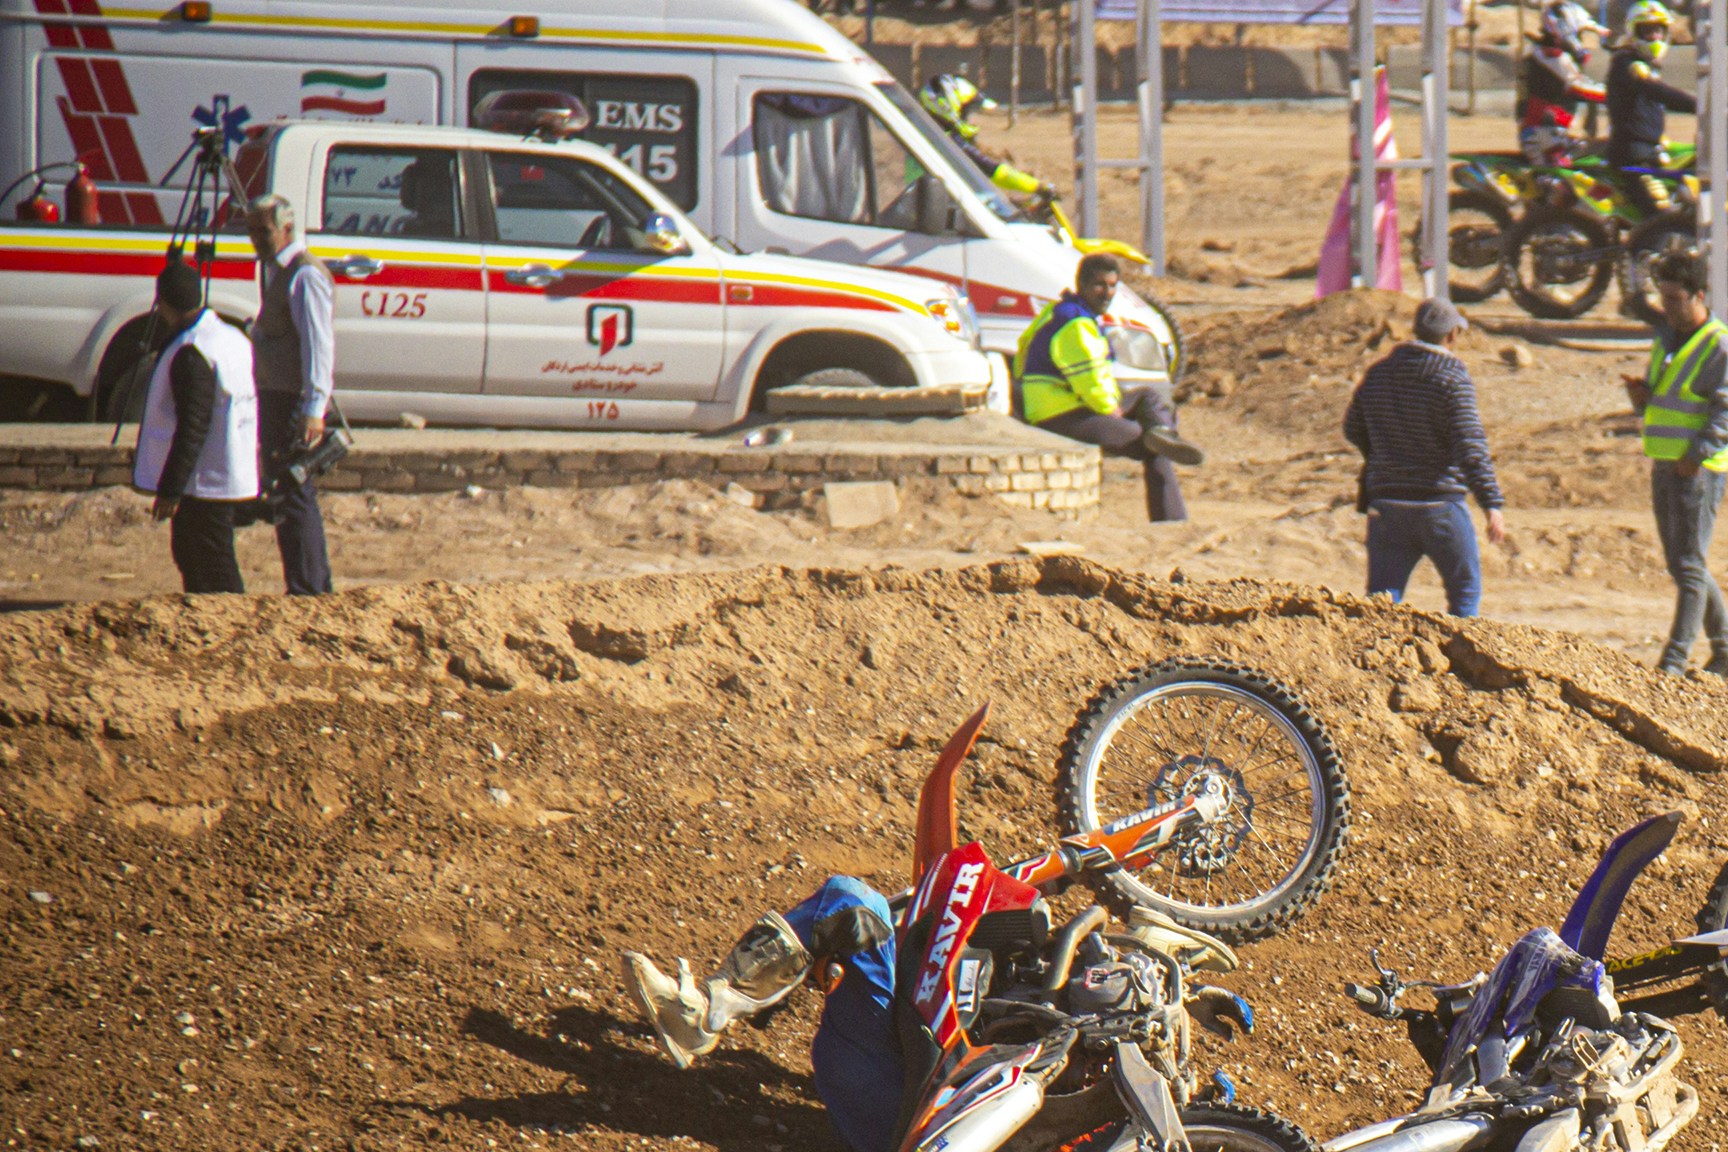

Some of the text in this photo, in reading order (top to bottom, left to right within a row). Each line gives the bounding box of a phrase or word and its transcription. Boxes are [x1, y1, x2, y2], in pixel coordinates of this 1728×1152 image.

[595, 100, 683, 133] EMS
[376, 292, 428, 319] 125
[587, 401, 620, 420] ۱۲۵
[1112, 803, 1177, 833] KAVIR
[915, 862, 985, 1006] KAVIR
